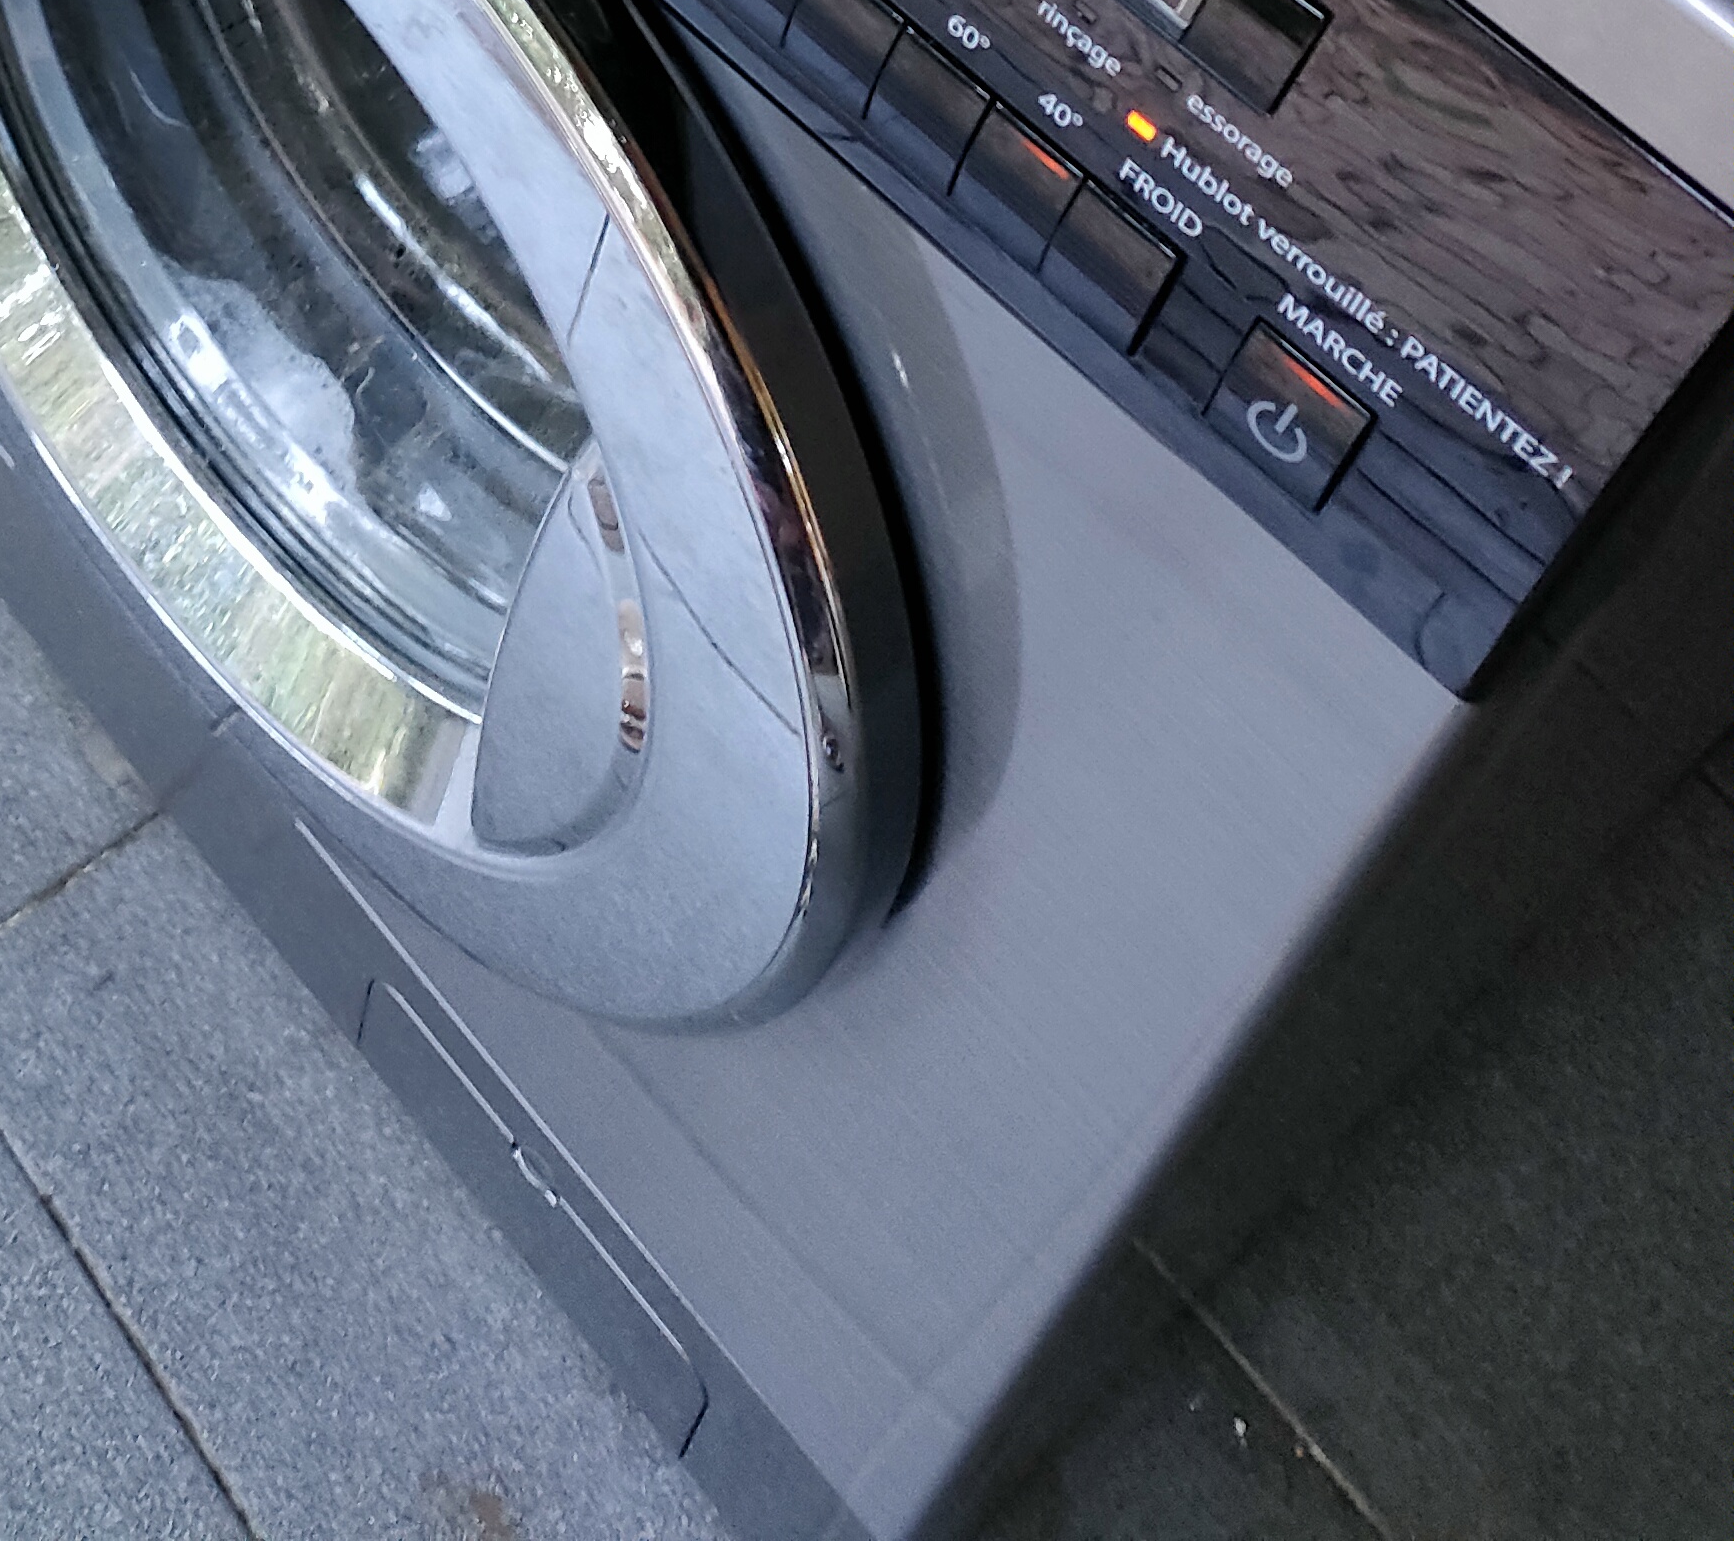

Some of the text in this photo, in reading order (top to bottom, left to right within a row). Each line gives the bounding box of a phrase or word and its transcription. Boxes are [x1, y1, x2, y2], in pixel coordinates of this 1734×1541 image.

[1038, 1, 1121, 76] rinçage
[1186, 94, 1293, 187] essorage
[1119, 159, 1203, 237] FROID
[1161, 137, 1254, 225] Hublot
[1258, 219, 1385, 335] verrouillé
[1381, 328, 1399, 347] :
[1401, 337, 1557, 475] PATIENTEZ
[1278, 294, 1402, 405] MARCHE
